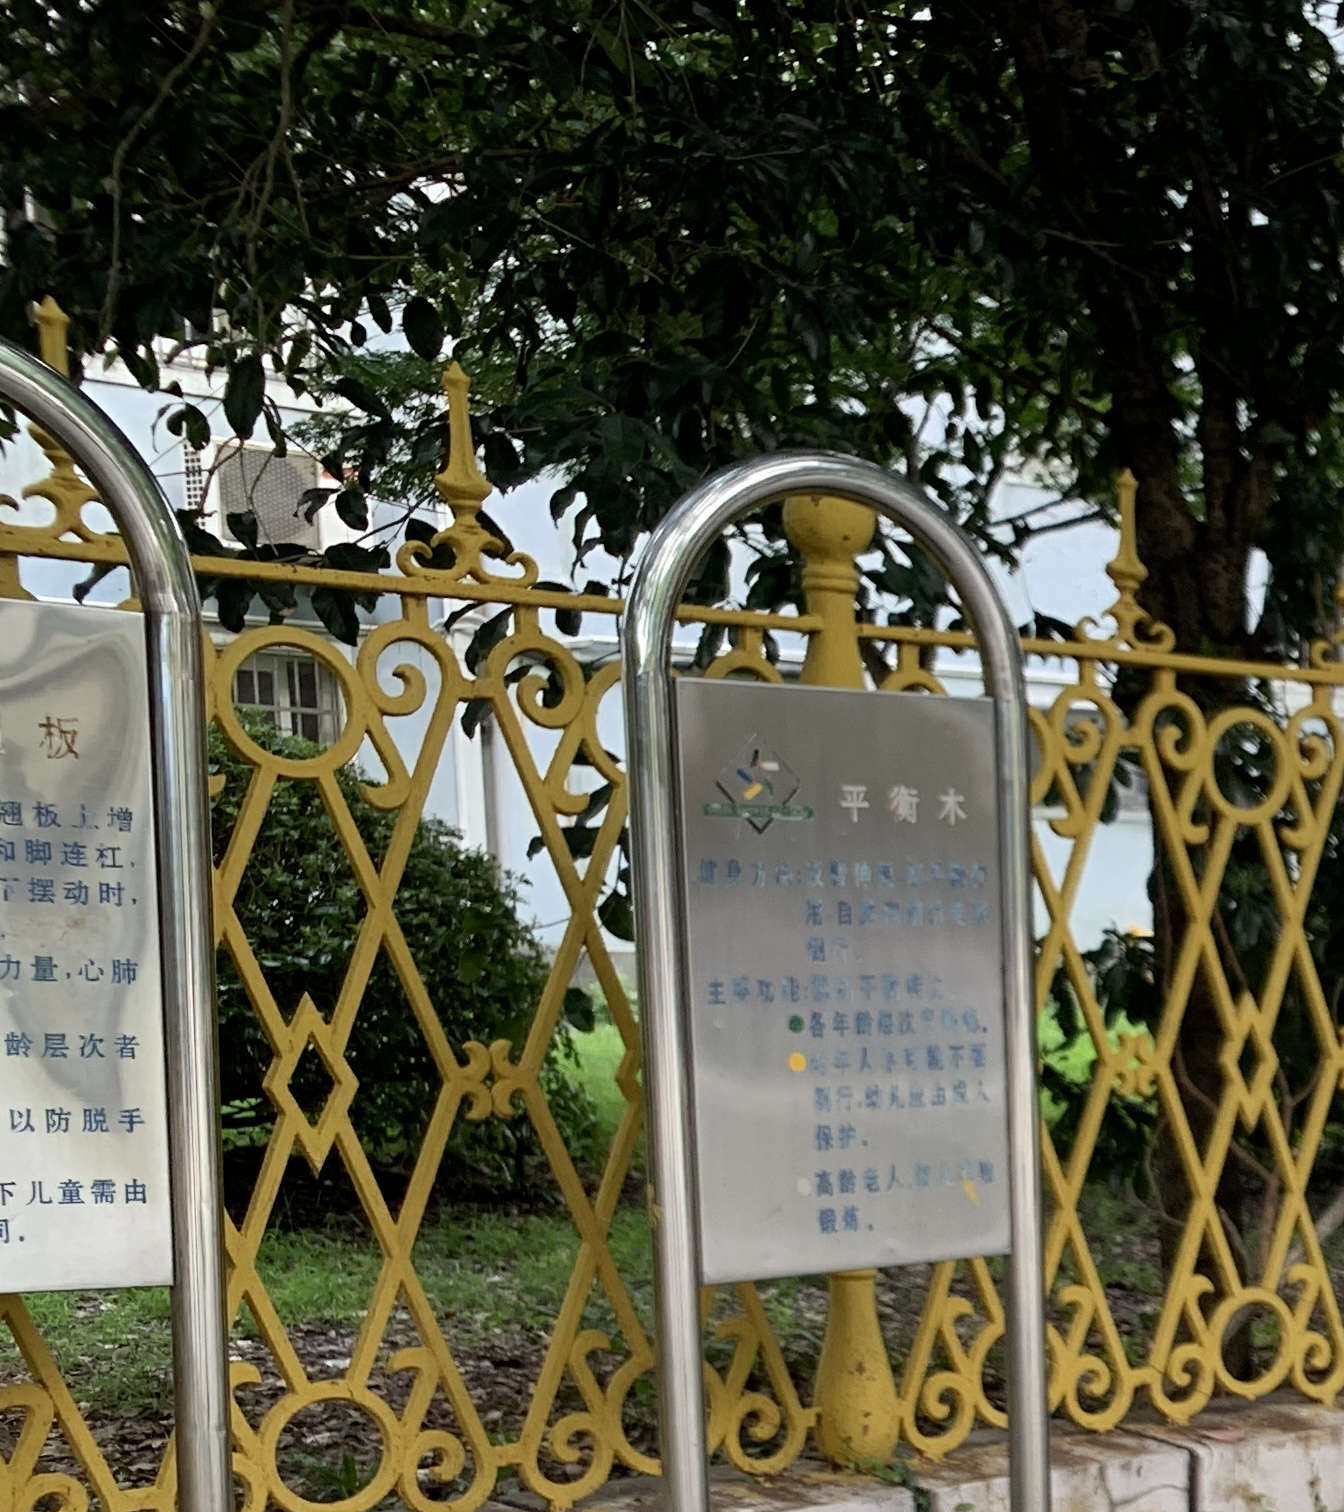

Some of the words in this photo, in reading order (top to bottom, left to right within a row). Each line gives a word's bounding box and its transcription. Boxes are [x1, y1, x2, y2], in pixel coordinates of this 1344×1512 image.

[38, 715, 80, 760] 板
[840, 784, 968, 826] 平衡木
[4, 1032, 140, 1060] 龄层次者
[9, 1107, 145, 1134] 以防脱手
